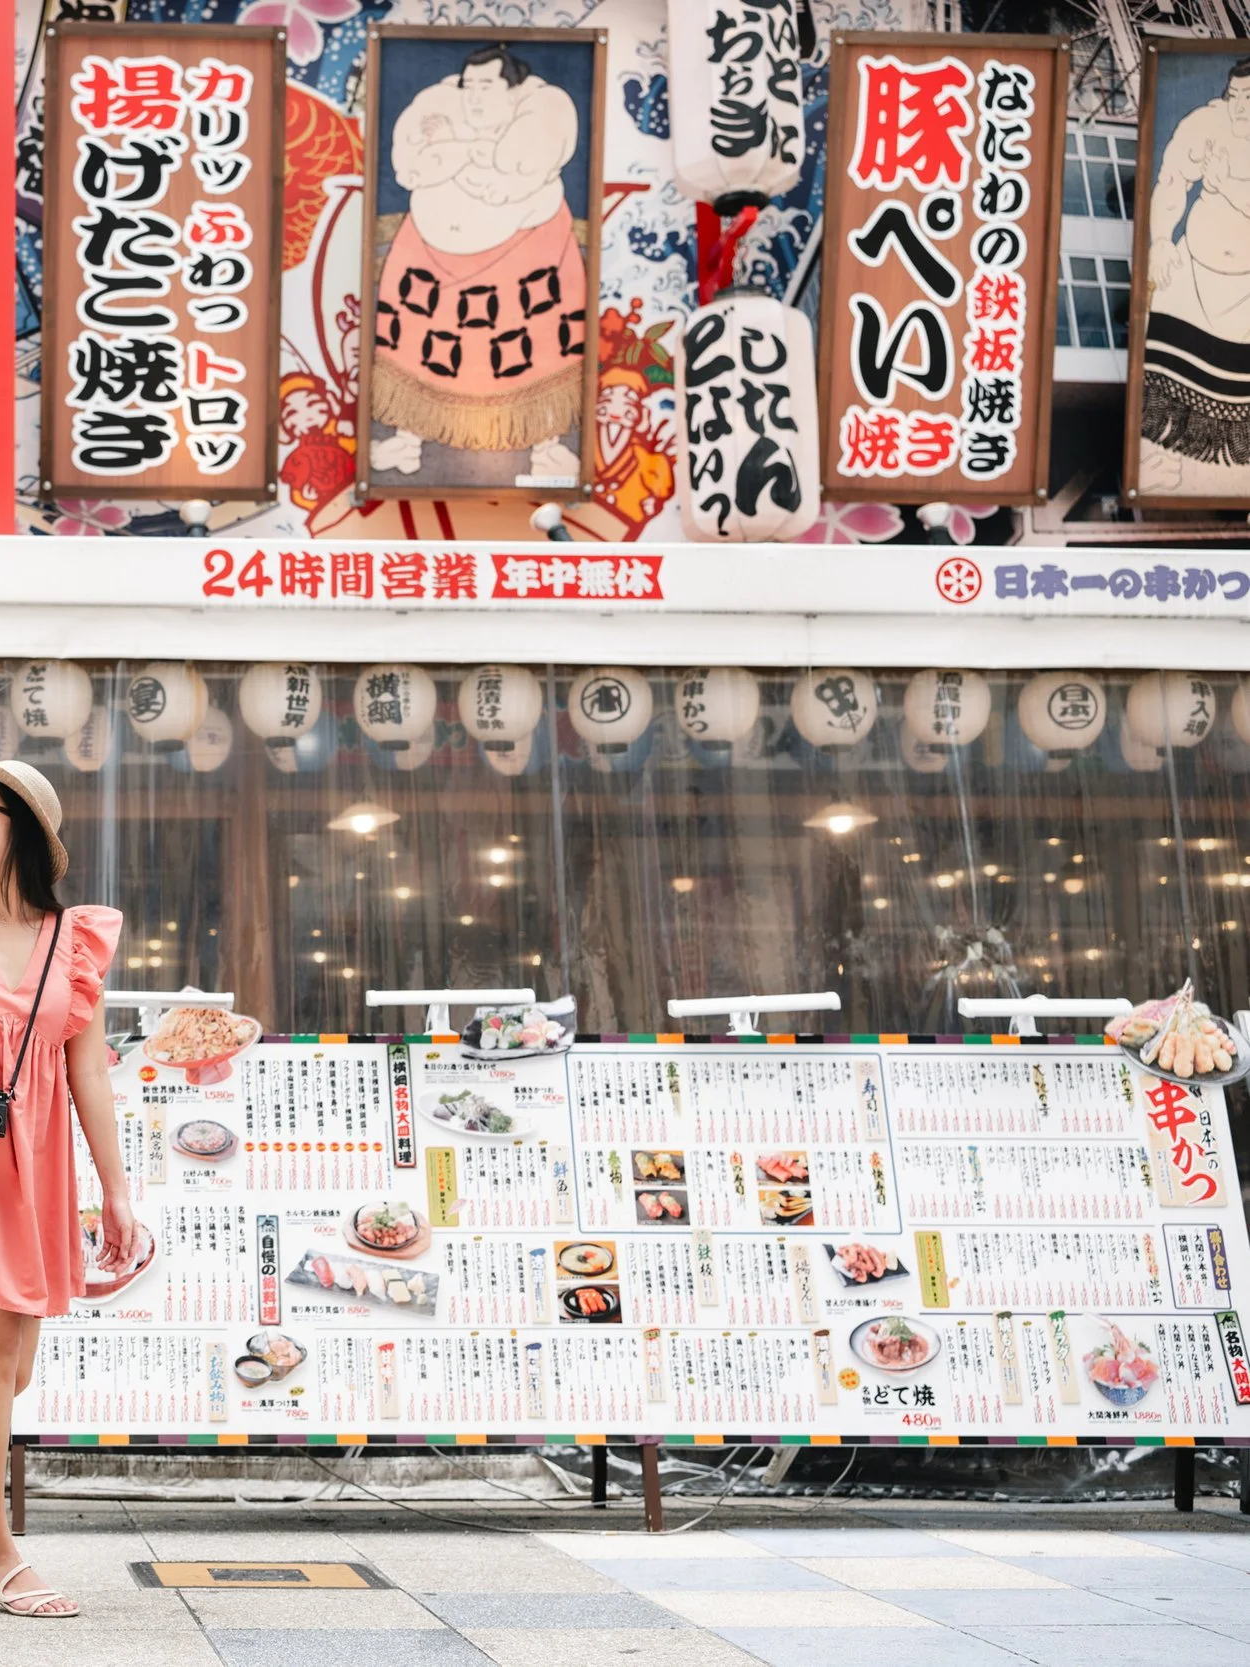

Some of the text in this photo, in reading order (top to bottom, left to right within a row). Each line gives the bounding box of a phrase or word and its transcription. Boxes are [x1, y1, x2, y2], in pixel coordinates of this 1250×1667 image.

[78, 62, 180, 470] 揚げたこ焼き
[190, 66, 250, 469] カリッ ふわっ トロッ
[841, 60, 971, 473] 豚ぺい焼き
[963, 66, 1030, 474] なにわの鉄板焼き
[202, 549, 654, 600] 24時間営業 年中無休
[994, 564, 1250, 601] 日本一の串かつ
[284, 677, 311, 728] 新世界
[366, 673, 404, 725] 横綱
[682, 669, 710, 733] 串かつ
[142, 1085, 199, 1095] 新世界焼きそば
[393, 1061, 412, 1163] 横綱名物大皿料理
[862, 1077, 878, 1112] 寿司
[1146, 1078, 1218, 1205] 串かつ
[1200, 1110, 1218, 1170] 日本一の
[183, 1169, 217, 1177] お好み焼き
[285, 1208, 341, 1217] ホルモン鉄板焼き
[260, 1235, 277, 1321] 自慢の鍋料理
[475, 1243, 483, 1293] ローストビーフ
[696, 1243, 714, 1277] 鉄板
[1209, 1231, 1229, 1288] 盛り合わせ
[116, 1309, 153, 1319] 3,600円
[825, 1299, 878, 1308] 甘えびの唐揚げ
[39, 1336, 47, 1387] ソフトドリンク
[1173, 1323, 1185, 1370] 大関かつ丼
[1187, 1323, 1200, 1382] 大関うな玉丼
[1201, 1323, 1214, 1373] 大関鉄火丼
[1224, 1330, 1250, 1402] 名物大関丼
[210, 1356, 225, 1403] お飲み物
[259, 1399, 299, 1408] 濃厚つけ麺
[862, 1386, 871, 1405] 名物
[874, 1384, 936, 1406] どて焼
[902, 1413, 942, 1427] 480円
[1087, 1411, 1130, 1420] 大関海鮮丼
